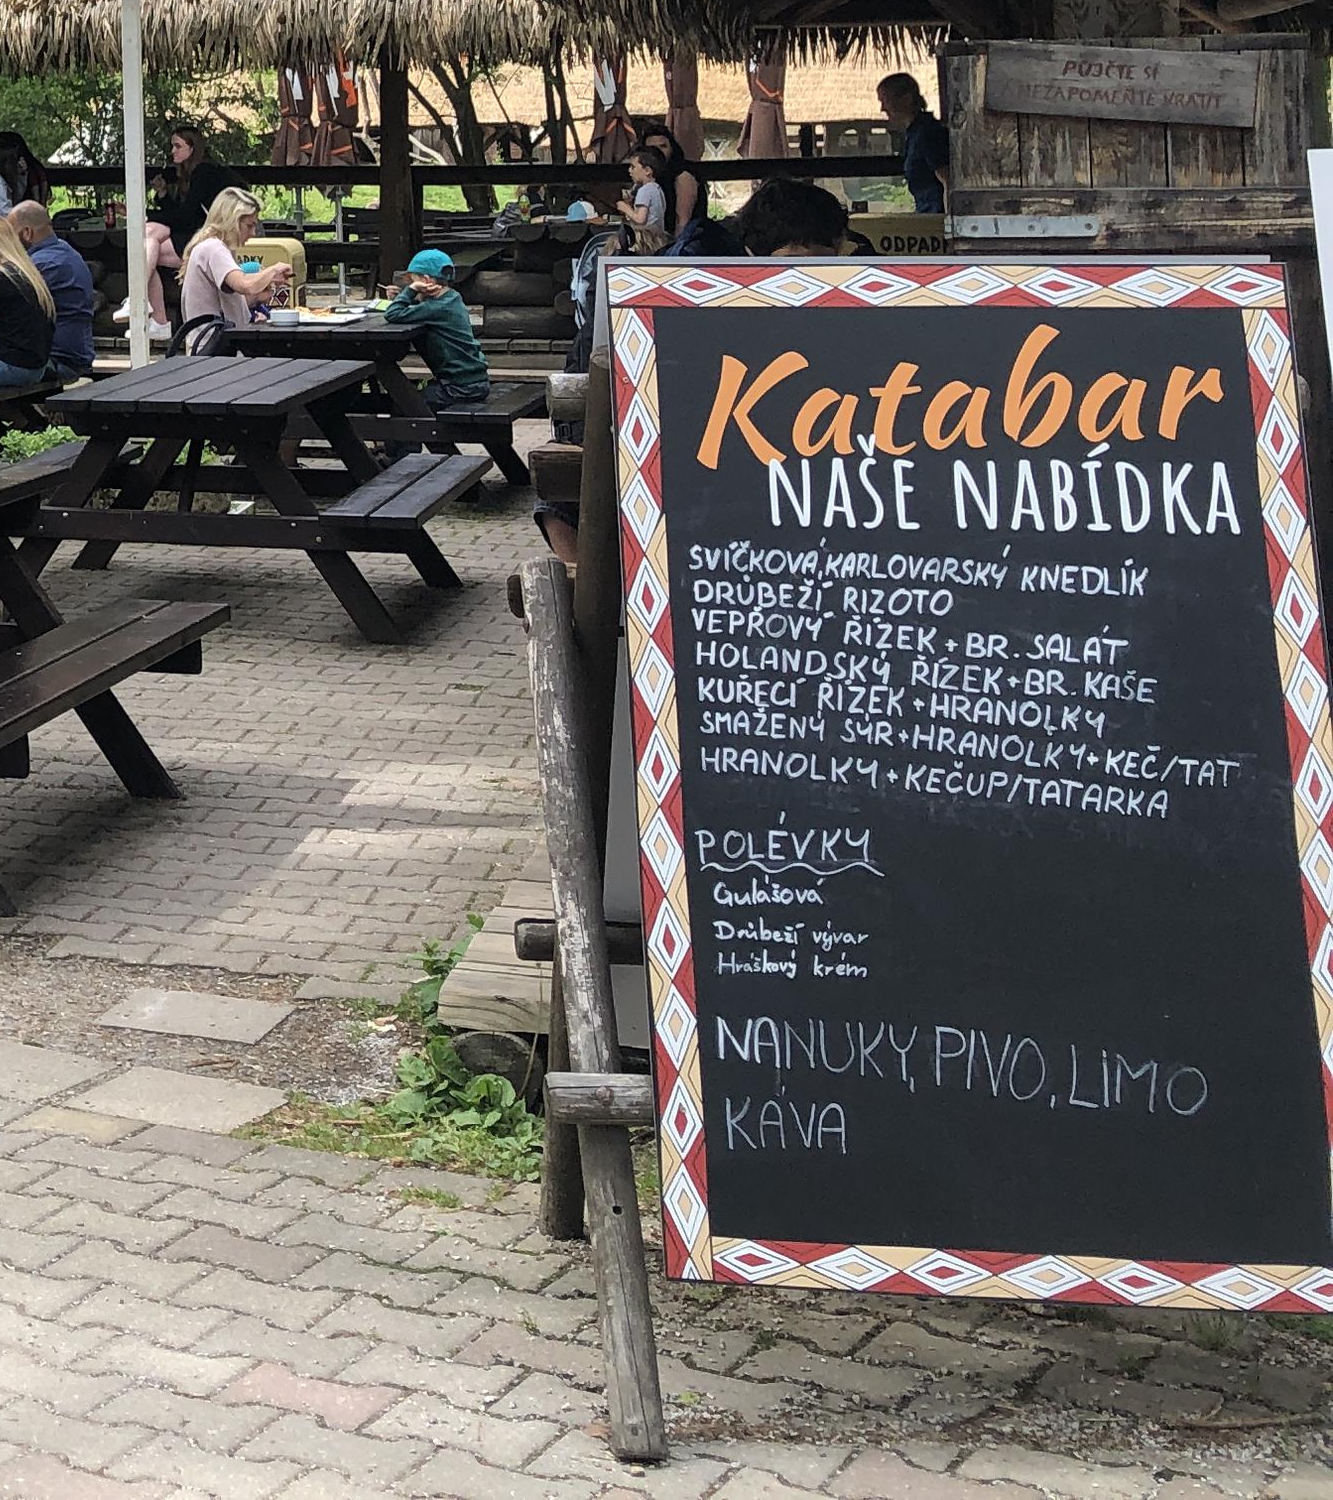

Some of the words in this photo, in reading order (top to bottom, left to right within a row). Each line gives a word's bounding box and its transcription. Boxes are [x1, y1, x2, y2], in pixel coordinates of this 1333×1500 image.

[697, 323, 1224, 470] Katabar
[768, 434, 920, 530] NAŠE
[954, 443, 1241, 534] NABÍDKA
[693, 574, 833, 612] DRŮBEŽÍ
[843, 586, 954, 616] RIZOTO
[1020, 558, 1149, 597] KNEDLÍK
[691, 606, 835, 641] VEPŘOVÝ
[843, 615, 938, 654] ŘÍZEK
[966, 632, 1020, 660] BR.
[1026, 625, 1129, 666] SALÁT
[696, 640, 891, 684] HOLANDSKÝ
[1084, 670, 1158, 704] KAŠE
[697, 674, 807, 711] KUŘECÍ
[818, 676, 906, 717] ŘÍZEK
[699, 706, 826, 742] SMAŽENÝ
[701, 747, 879, 789] HRANOLKY
[694, 811, 871, 864] POLÉVKY
[713, 874, 826, 907] Gulášová
[712, 916, 805, 945] Drůbeží
[812, 920, 869, 952] vývar
[718, 949, 798, 979] Hráškový
[813, 952, 868, 978] krém
[716, 1016, 918, 1093] NANUKY,
[935, 1025, 1056, 1109] PIVO,
[725, 1084, 848, 1154] KÁVA
